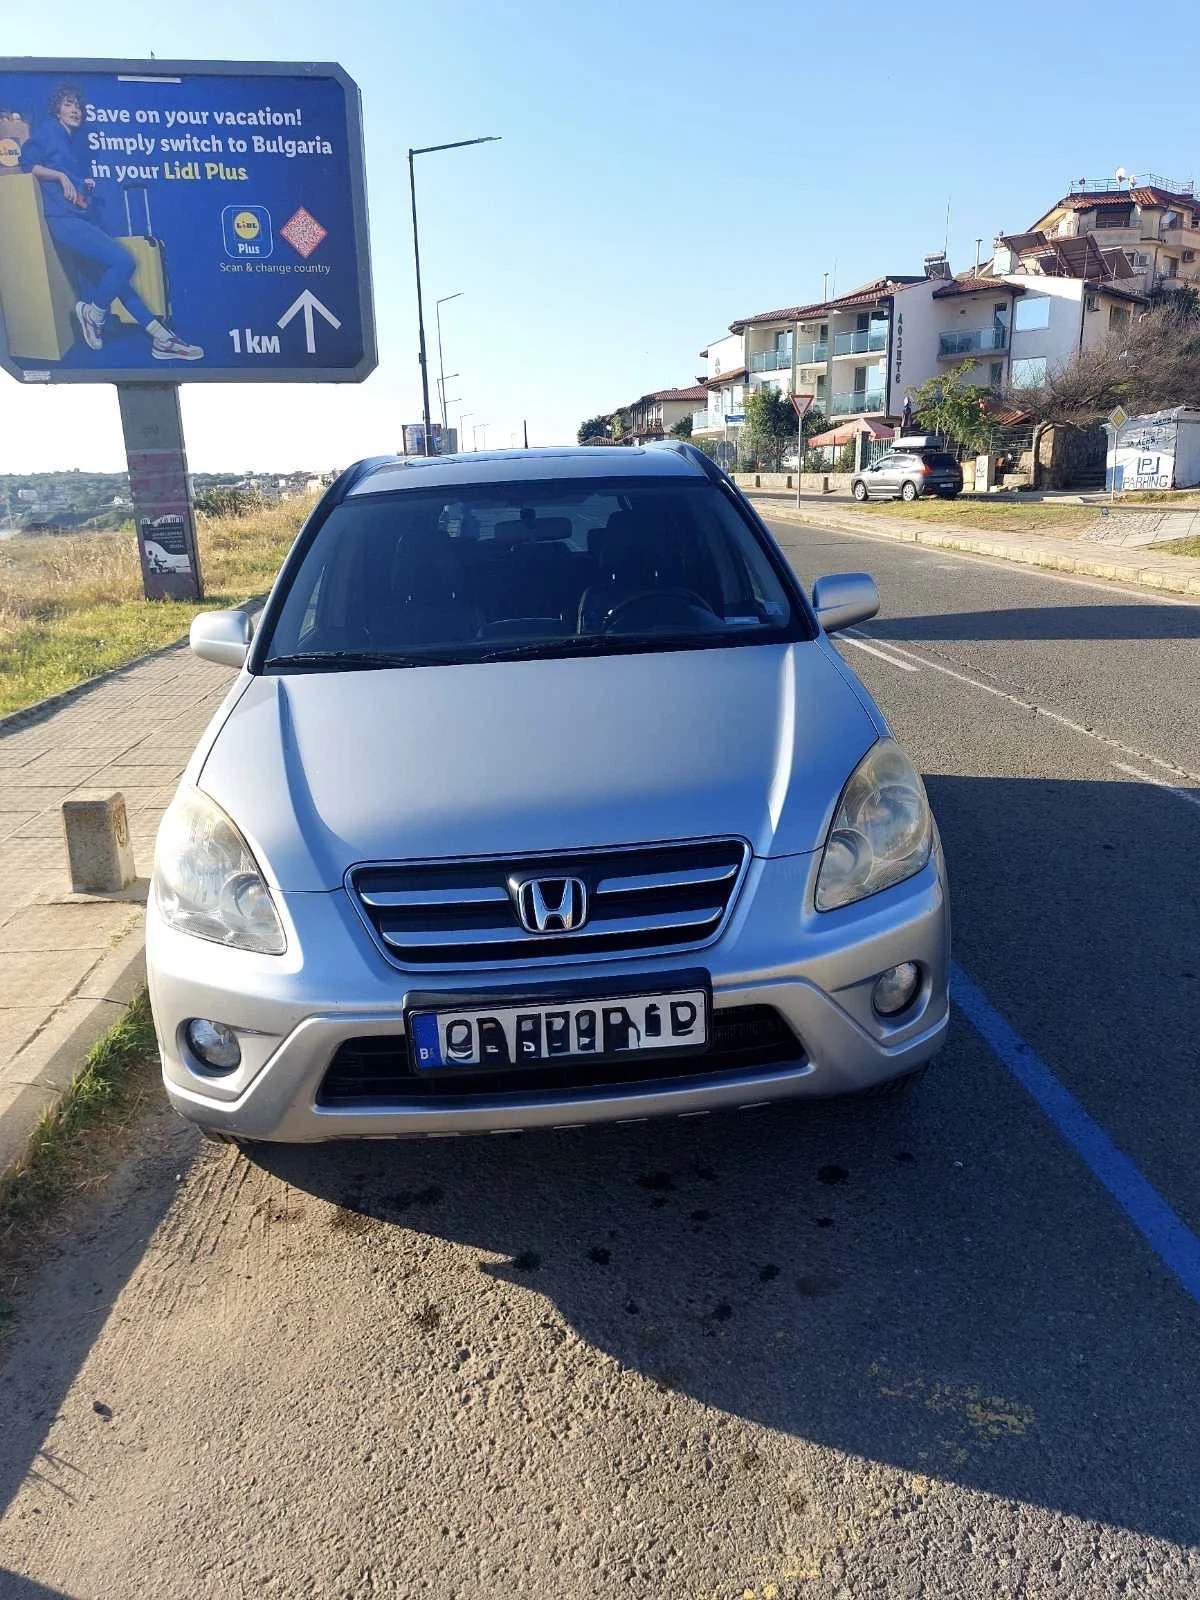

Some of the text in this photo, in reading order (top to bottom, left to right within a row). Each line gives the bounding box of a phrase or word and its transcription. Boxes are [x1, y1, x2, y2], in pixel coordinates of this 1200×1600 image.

[85, 104, 302, 128] Save on your vacation!
[87, 131, 333, 158] Simply switch to Bulgaria
[91, 159, 249, 182] in your Lidl Plus
[237, 243, 260, 254] Plus
[219, 262, 331, 275] Scan & change country
